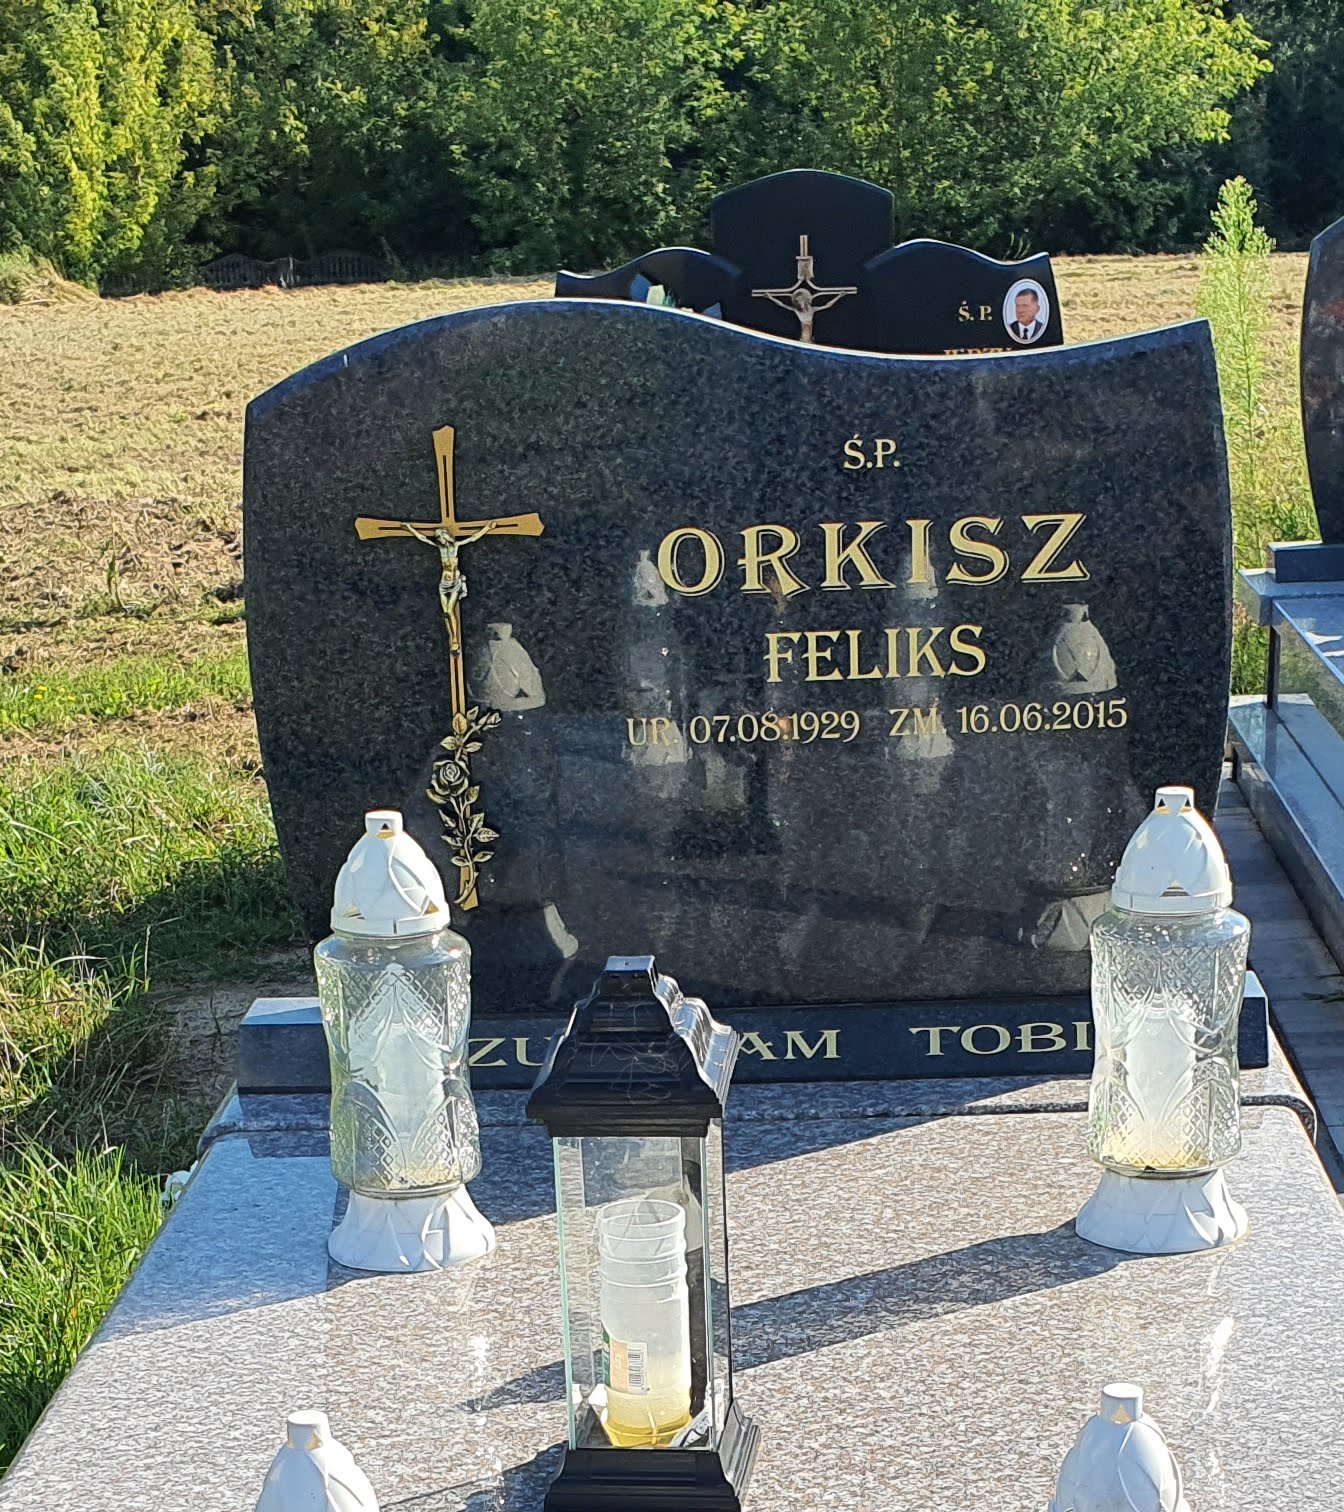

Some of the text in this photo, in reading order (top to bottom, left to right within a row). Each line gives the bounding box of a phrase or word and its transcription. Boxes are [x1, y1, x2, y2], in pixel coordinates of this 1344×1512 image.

[657, 512, 1091, 598] ORKISZ
[763, 624, 987, 683] FELIKS
[626, 699, 1128, 746] UR. 07.08.1929 ZM. 16.06.2015
[467, 1020, 1092, 1067] ZU AM TOBI
